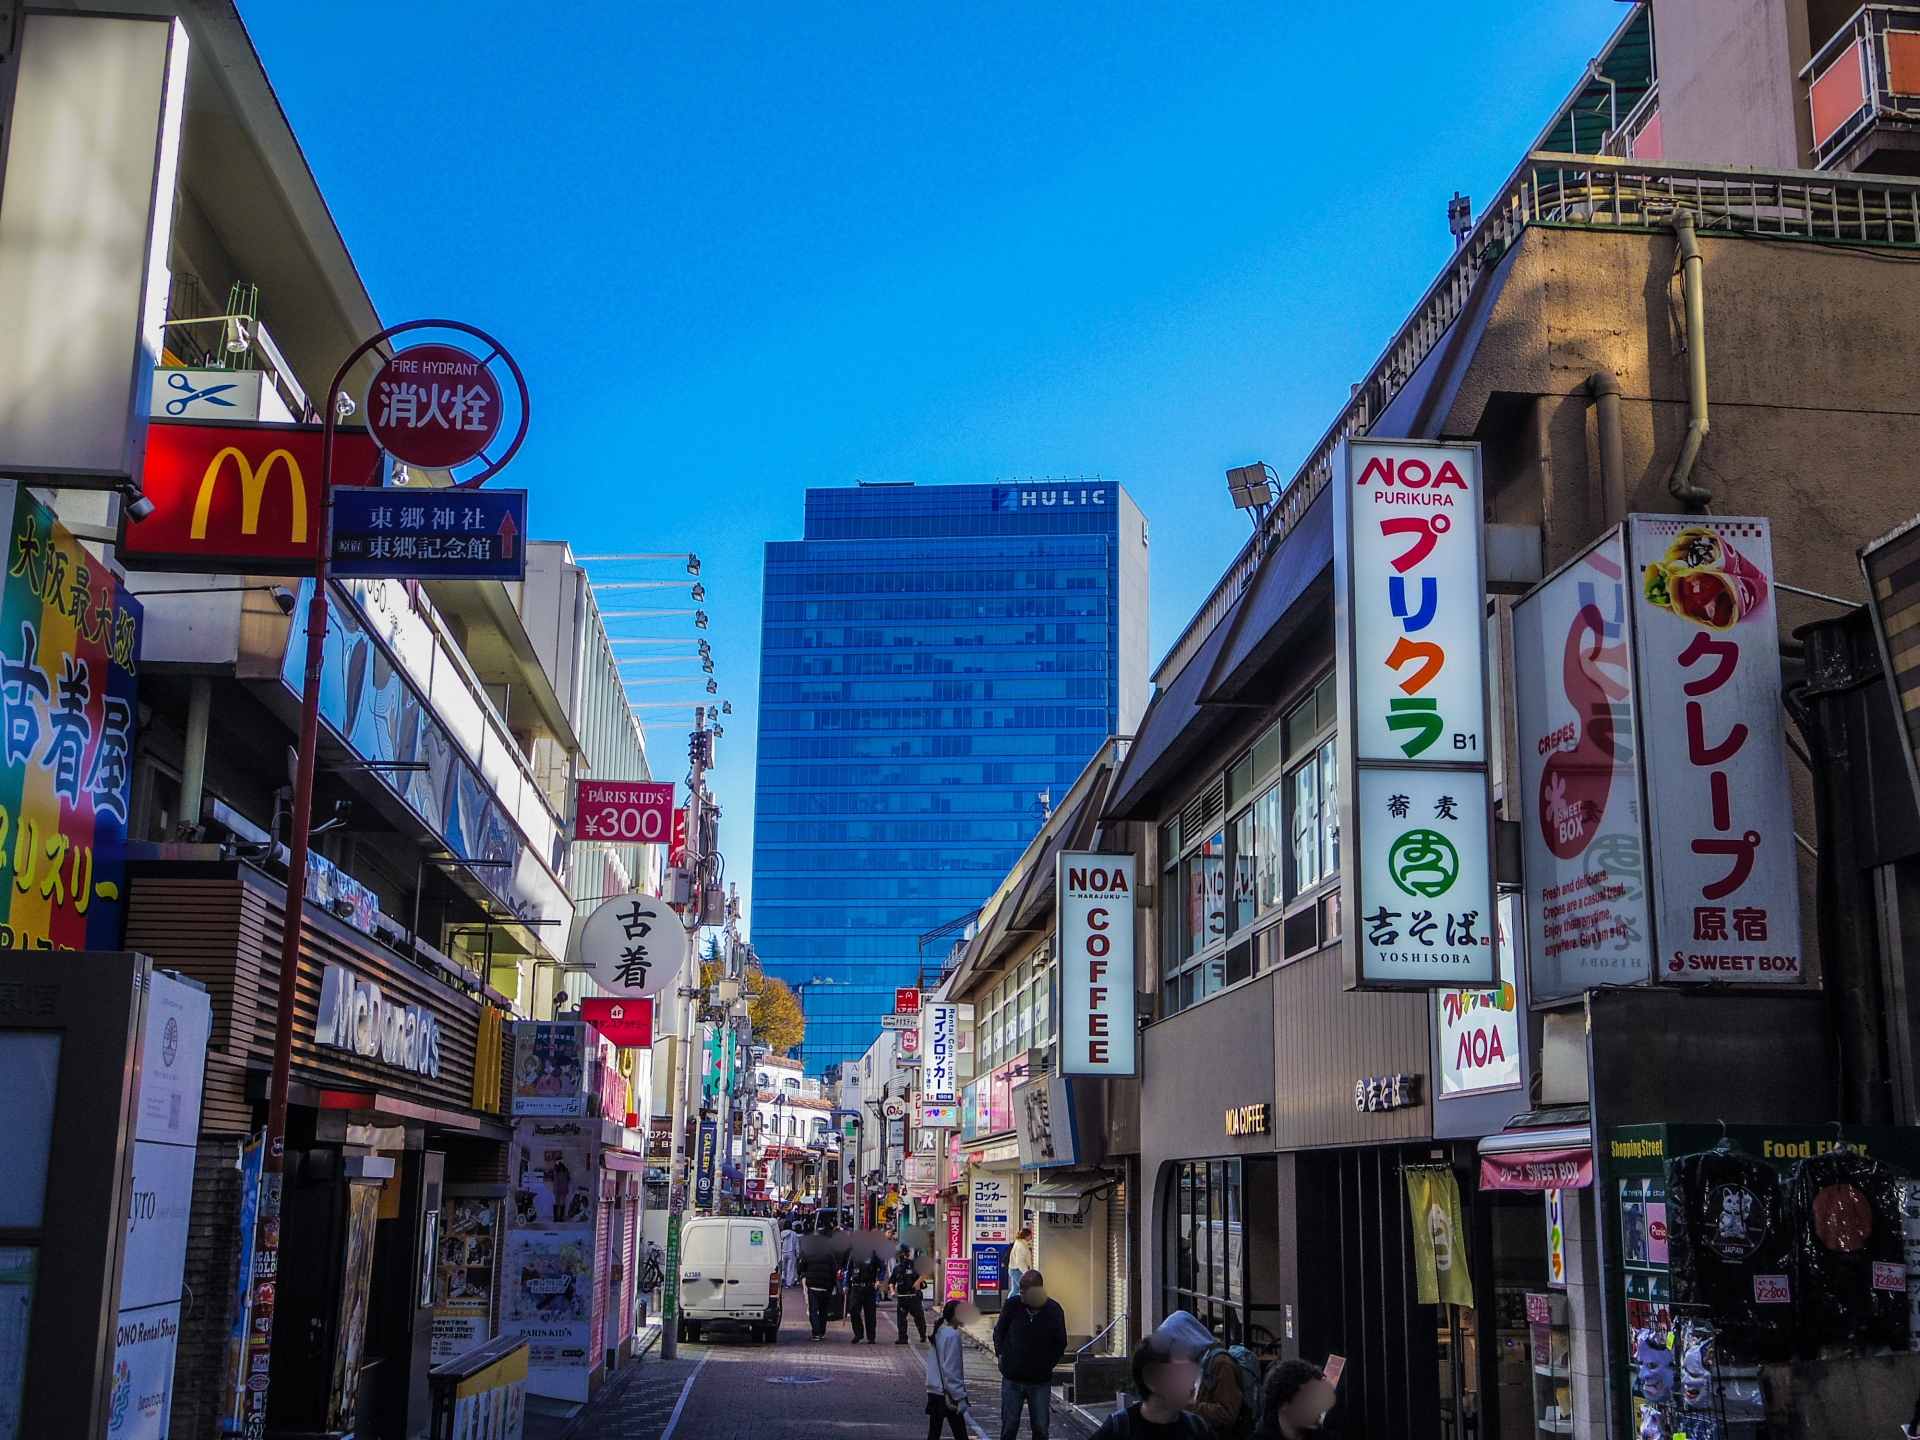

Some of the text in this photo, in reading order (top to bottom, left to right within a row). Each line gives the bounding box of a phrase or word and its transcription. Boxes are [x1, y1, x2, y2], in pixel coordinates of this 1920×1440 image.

[391, 360, 479, 376] FIRE HYDRANT
[379, 382, 491, 431] 消火栓
[1357, 457, 1468, 490] NOA
[1022, 489, 1105, 506] HULIC
[1375, 491, 1454, 506] PURIKURA
[368, 506, 486, 531] 東郷神社
[367, 536, 492, 560] 東郷記念館
[9, 514, 137, 677] 大阪最大級
[1380, 513, 1451, 759] プリクラ
[0, 620, 131, 825] 古着屋
[1453, 733, 1477, 751] B1
[1539, 722, 1575, 755] CREPES
[1678, 631, 1761, 900] クレープ
[588, 788, 664, 805] PARIS KID'S
[1386, 794, 1459, 821] 蕎麦
[585, 807, 663, 838] ¥300
[1559, 800, 1582, 821] SWEET
[1559, 815, 1584, 844] BOX
[1068, 867, 1129, 892] NOA
[1543, 870, 1608, 902] Fresh and delicious.
[1544, 905, 1565, 920] Crepes
[1567, 900, 1577, 914] are
[1579, 898, 1582, 908] a
[1584, 887, 1606, 906] casual
[1363, 906, 1479, 947] 吉そば
[1544, 923, 1562, 940] Enjoy
[1564, 917, 1581, 932] them
[1693, 906, 1768, 941] 原宿
[612, 900, 657, 989] 古着
[1379, 951, 1471, 964] YOSHISOBA
[1688, 954, 1798, 971] SWEET BOX
[1086, 907, 1111, 1064] COFFEE
[612, 1009, 622, 1017] 4F
[948, 1008, 956, 1036] Rental
[934, 1008, 947, 1090] コインロッカー
[947, 1039, 955, 1058] Coin
[1456, 1024, 1506, 1071] NOA
[926, 1093, 934, 1101] 1F
[1225, 1103, 1265, 1136] NOA COFFEE
[702, 1133, 712, 1174] GALLERY
[1611, 1139, 1663, 1158] Shopping Street
[1763, 1140, 1811, 1159] Food
[1526, 1163, 1557, 1181] SWEET
[1560, 1162, 1579, 1179] BOX
[975, 1182, 1000, 1191] コイン
[975, 1193, 1008, 1201] ロッカー
[1723, 1246, 1744, 1255] JAPAN
[1875, 1274, 1904, 1287] ¥2800
[1757, 1286, 1787, 1301] ¥2800
[138, 1319, 160, 1343] Rental
[161, 1317, 177, 1343] Shop
[520, 1327, 572, 1337] PARIS KID'S
